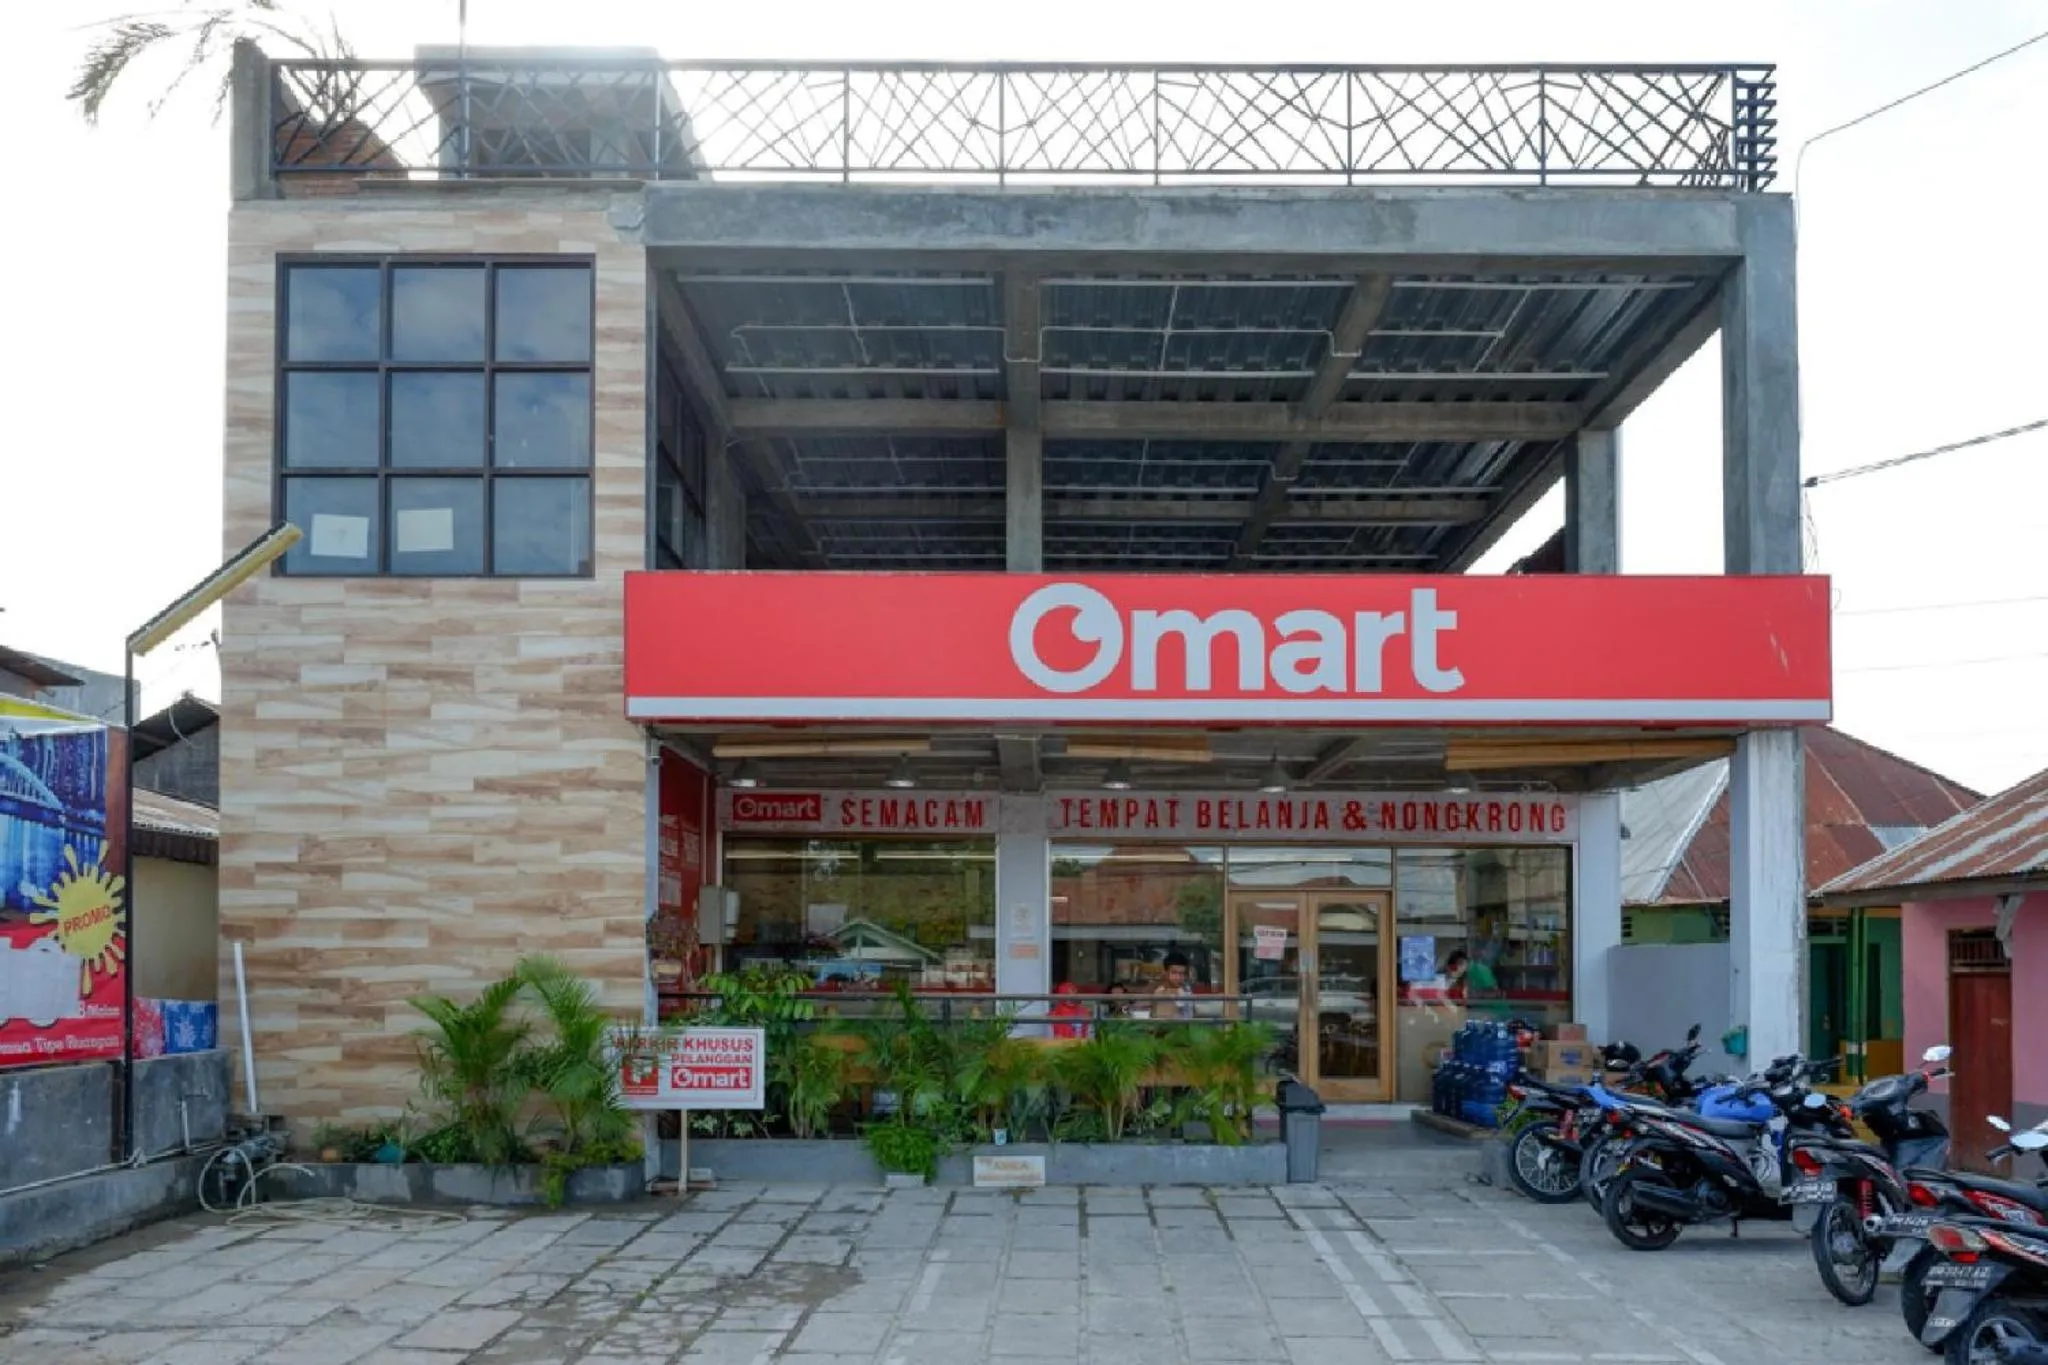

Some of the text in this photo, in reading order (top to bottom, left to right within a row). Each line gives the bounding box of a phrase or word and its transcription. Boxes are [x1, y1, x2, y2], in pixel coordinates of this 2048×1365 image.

[1008, 582, 1466, 693] Omart
[736, 797, 818, 818] Omart
[841, 798, 1566, 833] SEMACAM TEMPAT BELANJA & NONGKRONG
[63, 904, 111, 937] PROMO
[683, 1037, 753, 1051] KHUSUS
[671, 1053, 753, 1065] PELANGGAN
[674, 1067, 748, 1088] Omart
